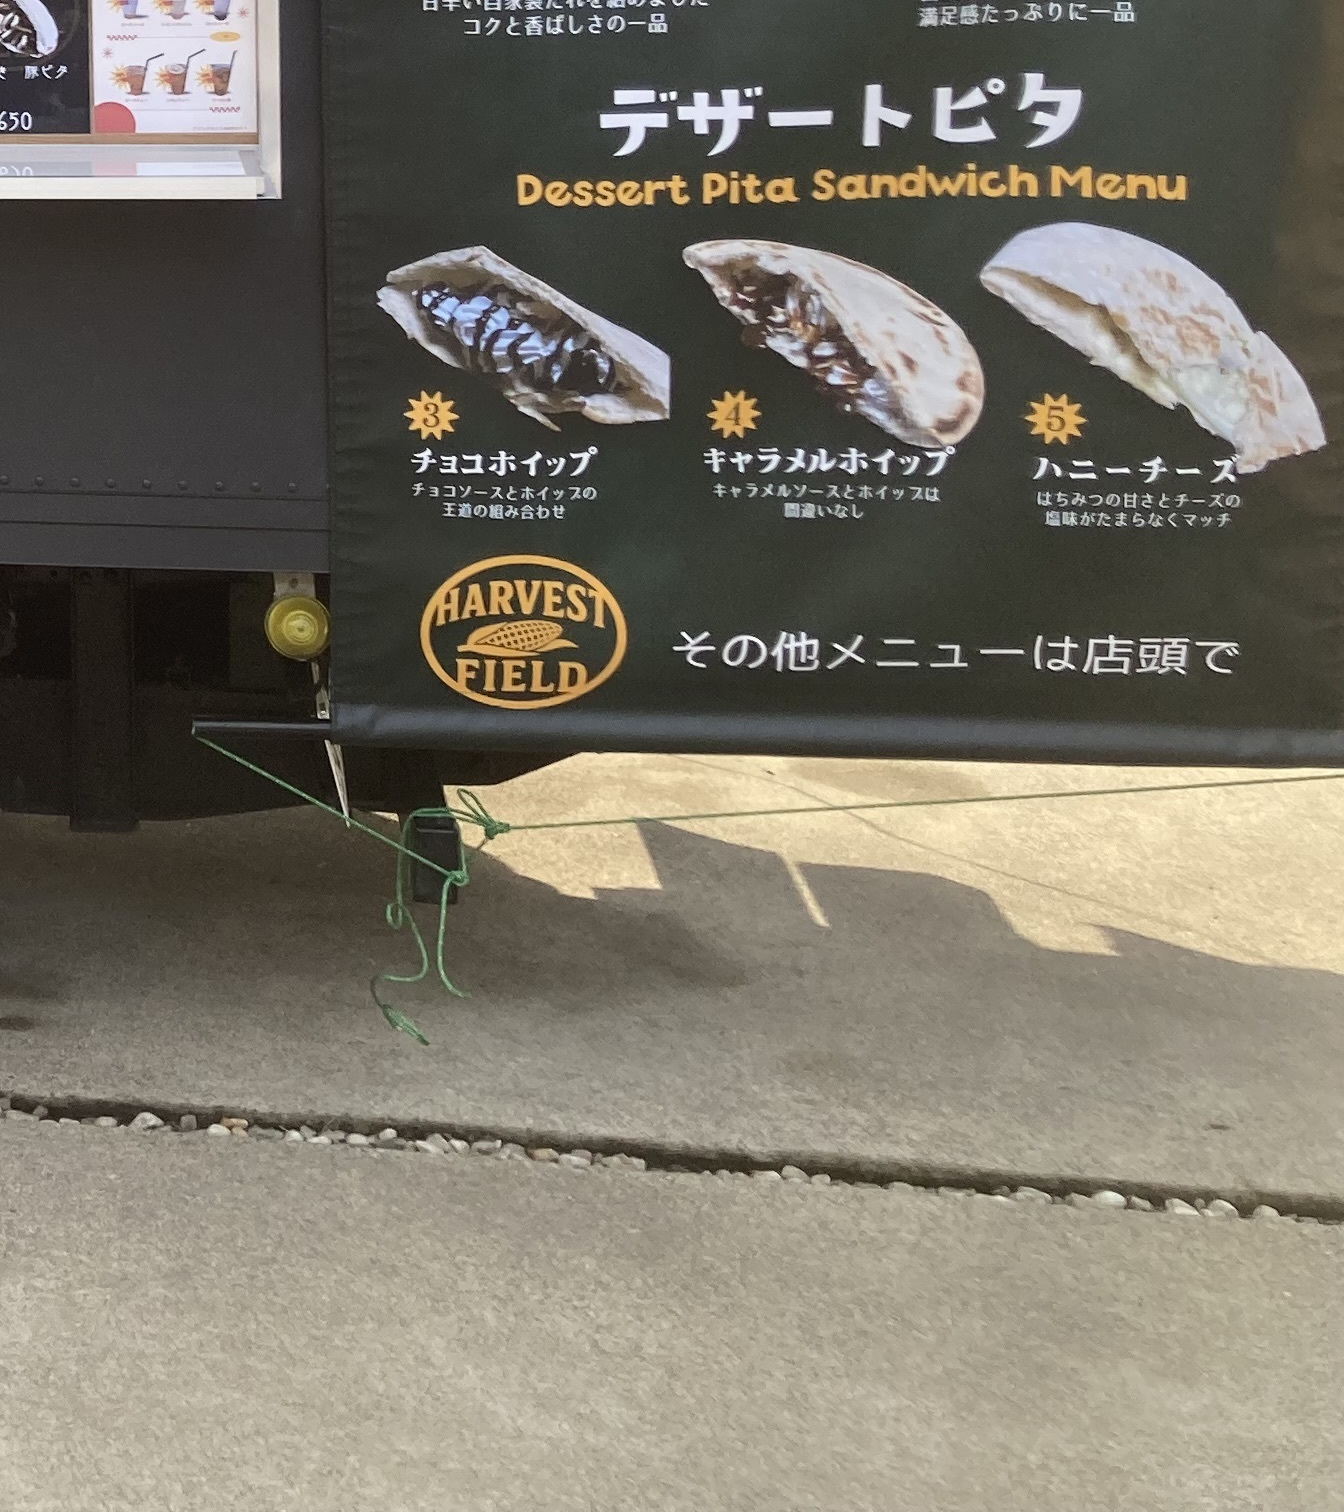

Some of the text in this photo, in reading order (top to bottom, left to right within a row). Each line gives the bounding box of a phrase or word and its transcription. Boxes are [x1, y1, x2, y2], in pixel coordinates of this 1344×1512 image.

[462, 12, 668, 36] コクと香ばしさの一品
[917, 1, 1136, 28] 満足感たっぷりに一品
[600, 72, 1082, 157] デザートピタ
[516, 162, 1188, 207] Dessert Pita Sandwich Menu
[423, 402, 440, 428] 3
[724, 402, 742, 427] 4
[1046, 405, 1066, 431] 5
[410, 445, 598, 477] チョコホイップ
[703, 444, 957, 477] キャラメルホイップ
[1032, 453, 1239, 483] ハニーチーズ
[442, 503, 566, 520] 王道の組み合わせ
[784, 502, 865, 520] 間違いなし
[1037, 490, 1241, 509] はちみつの甘さとチーズの
[1045, 510, 1233, 528] 塩味がたまらなくマッチ
[435, 579, 609, 629] HARVEST
[672, 630, 1240, 675] その他メニューは店頭で
[455, 658, 589, 693] FIELD
